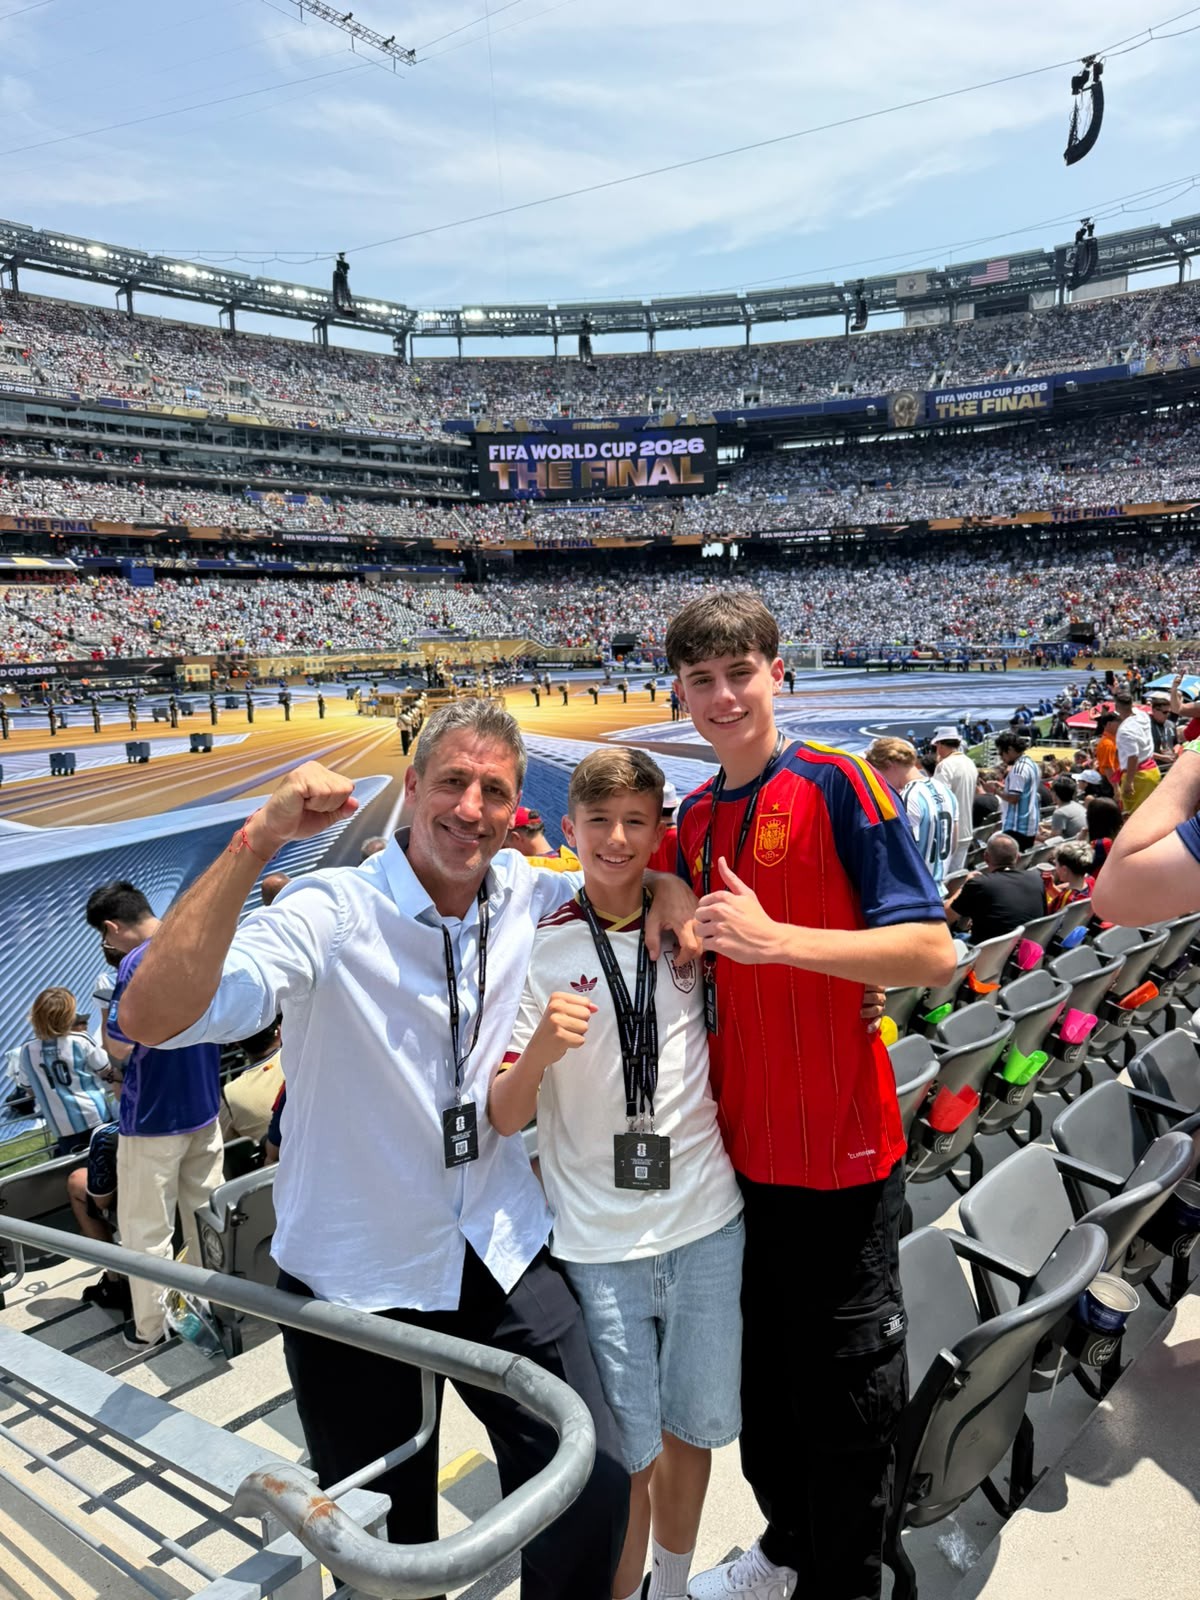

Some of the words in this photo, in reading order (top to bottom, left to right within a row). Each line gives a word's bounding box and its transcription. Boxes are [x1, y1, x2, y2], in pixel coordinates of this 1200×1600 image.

[935, 394, 955, 404] FIFA
[956, 390, 991, 402] WORLD
[993, 387, 1012, 397] CUP
[1013, 382, 1048, 394] 2026
[935, 400, 978, 418] THE
[982, 392, 1047, 414] FINAL
[488, 444, 528, 460] FIFA
[530, 443, 597, 460] WORLD
[600, 441, 637, 458] CUP
[639, 438, 705, 456] 2026
[489, 461, 573, 490] THE
[581, 456, 704, 488] FINAL
[1051, 508, 1081, 519] THE
[1083, 505, 1127, 517] FINAL
[13, 518, 48, 531] THE
[50, 519, 97, 532] FINAL
[534, 540, 559, 548] THE
[560, 538, 597, 547] FINAL
[8, 668, 26, 677] CUP
[27, 666, 57, 676] 2026
[39, 1060, 72, 1089] 10
